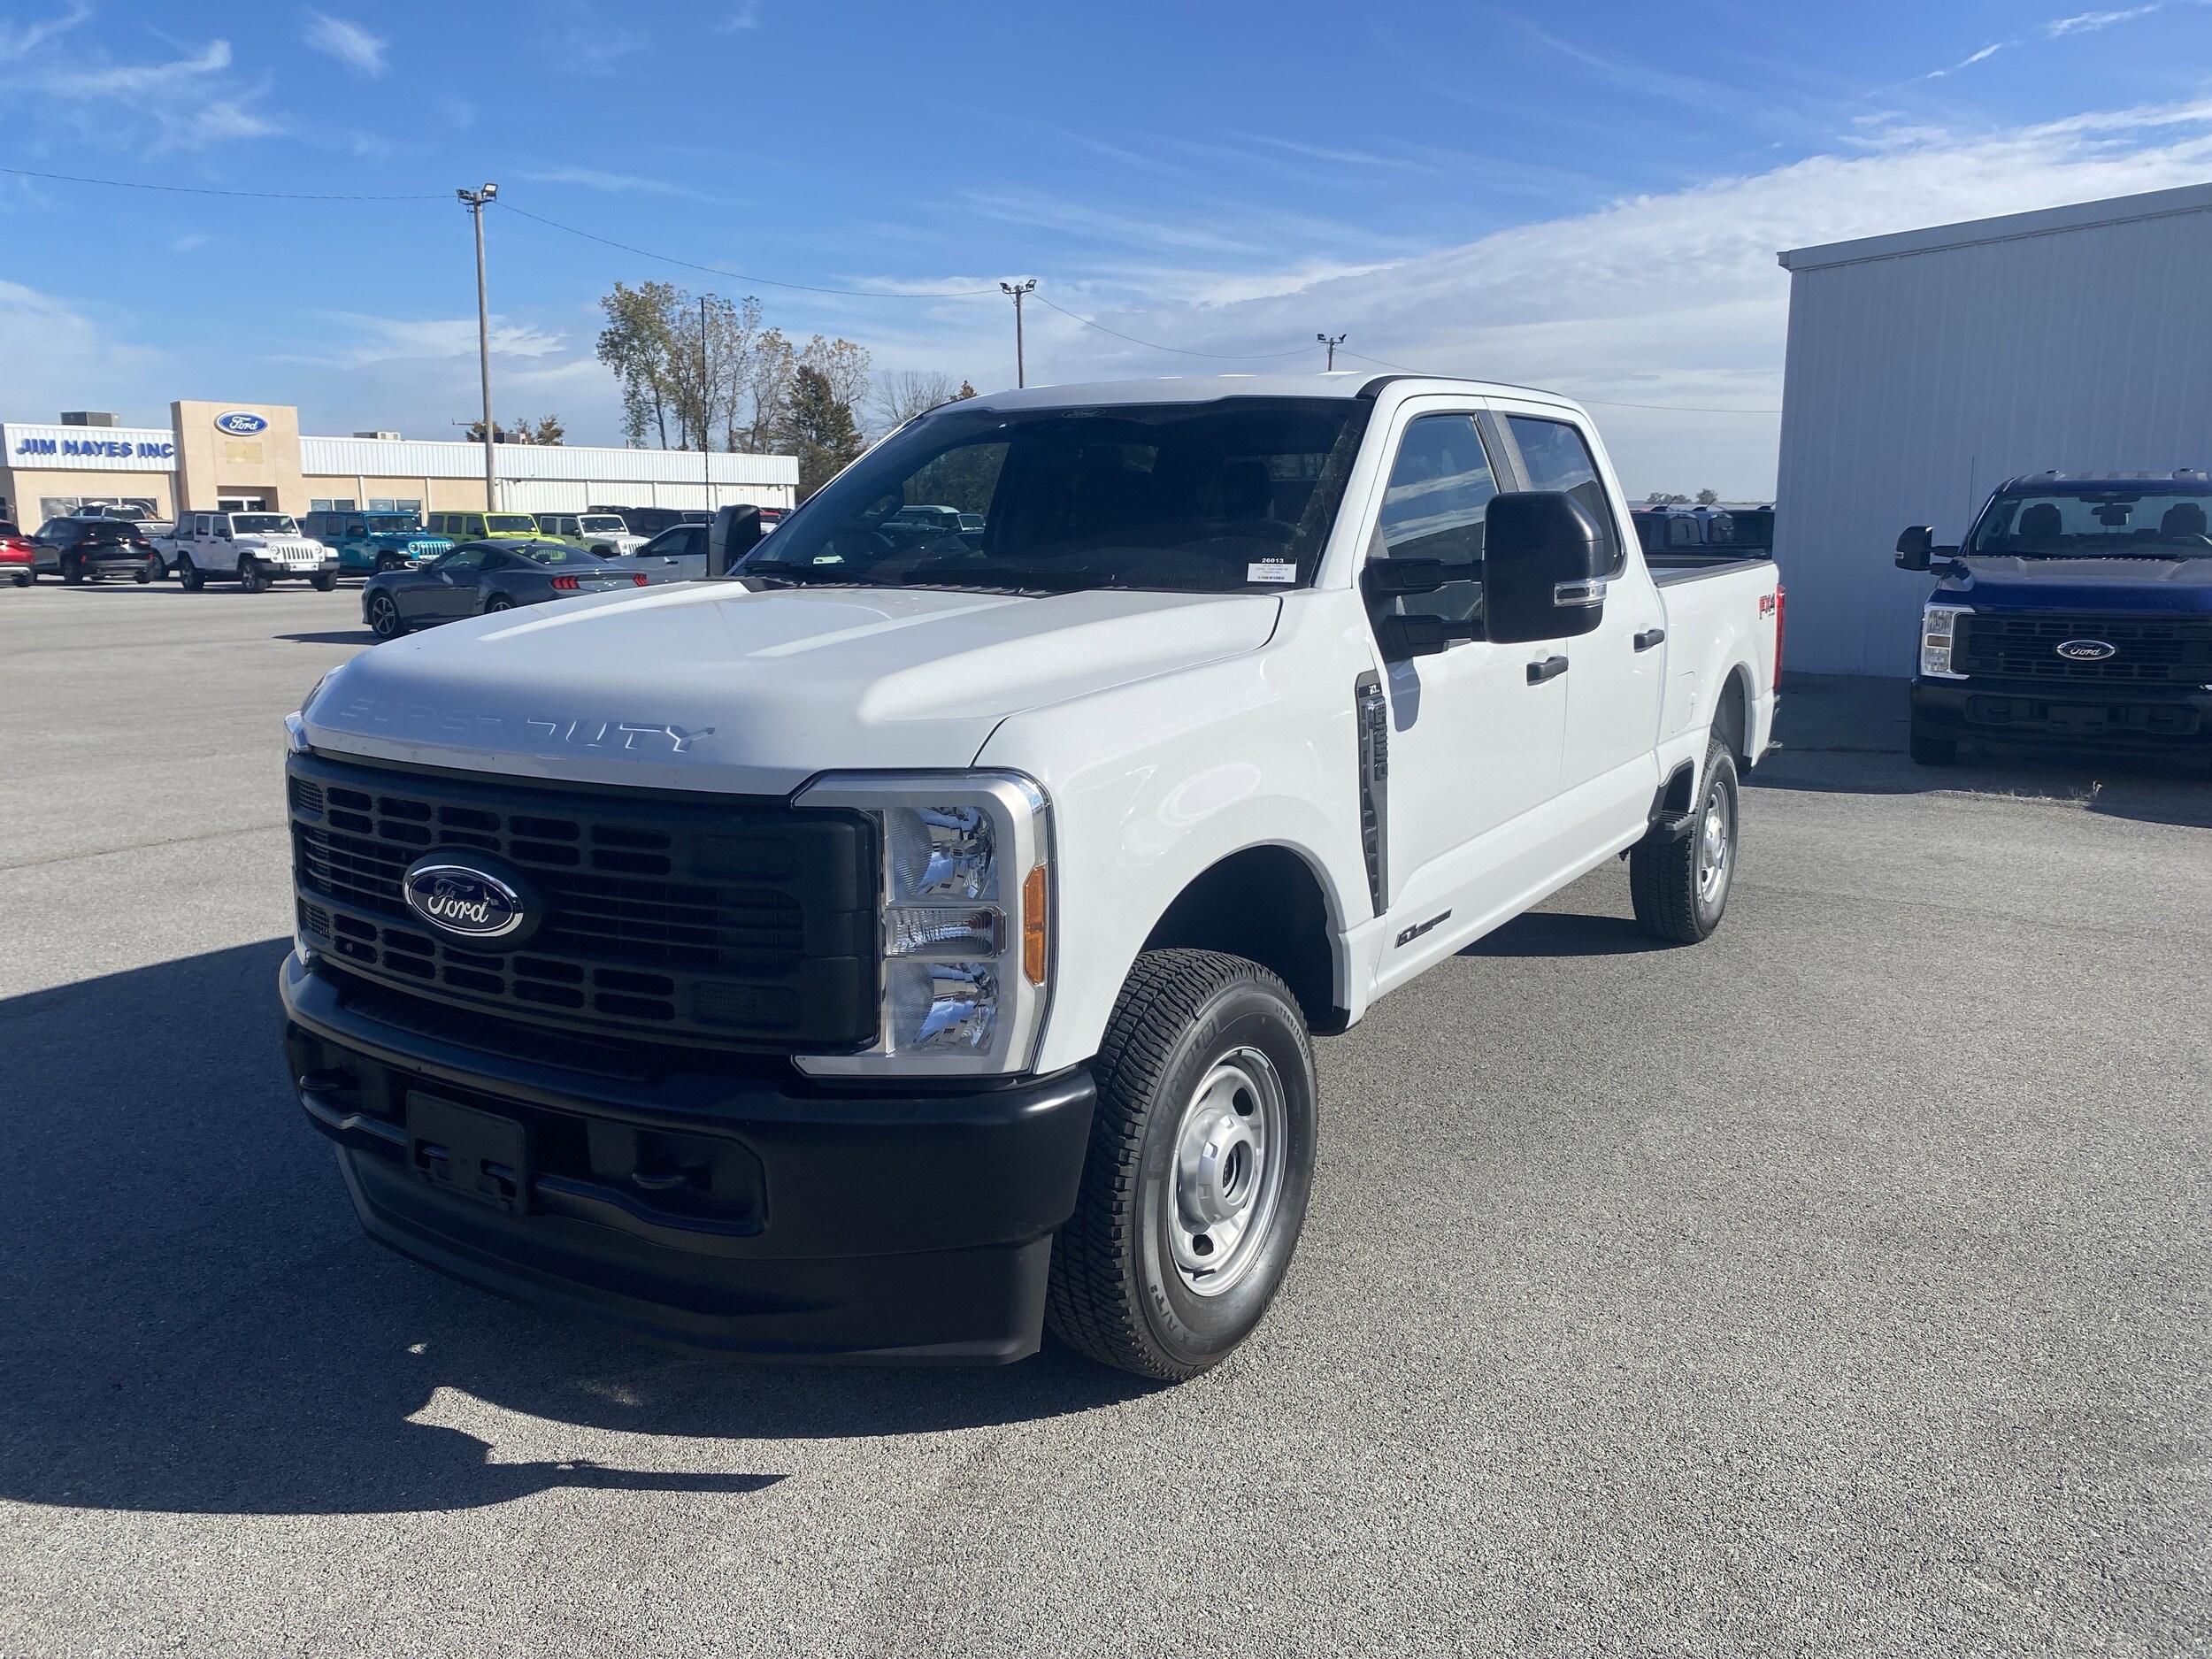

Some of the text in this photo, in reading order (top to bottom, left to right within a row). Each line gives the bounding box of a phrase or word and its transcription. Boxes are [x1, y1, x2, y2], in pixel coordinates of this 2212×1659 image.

[229, 416, 258, 430] Ford
[16, 438, 174, 458] JIM HAYES INC
[2070, 643, 2102, 656] Ford
[427, 878, 489, 924] Ford
